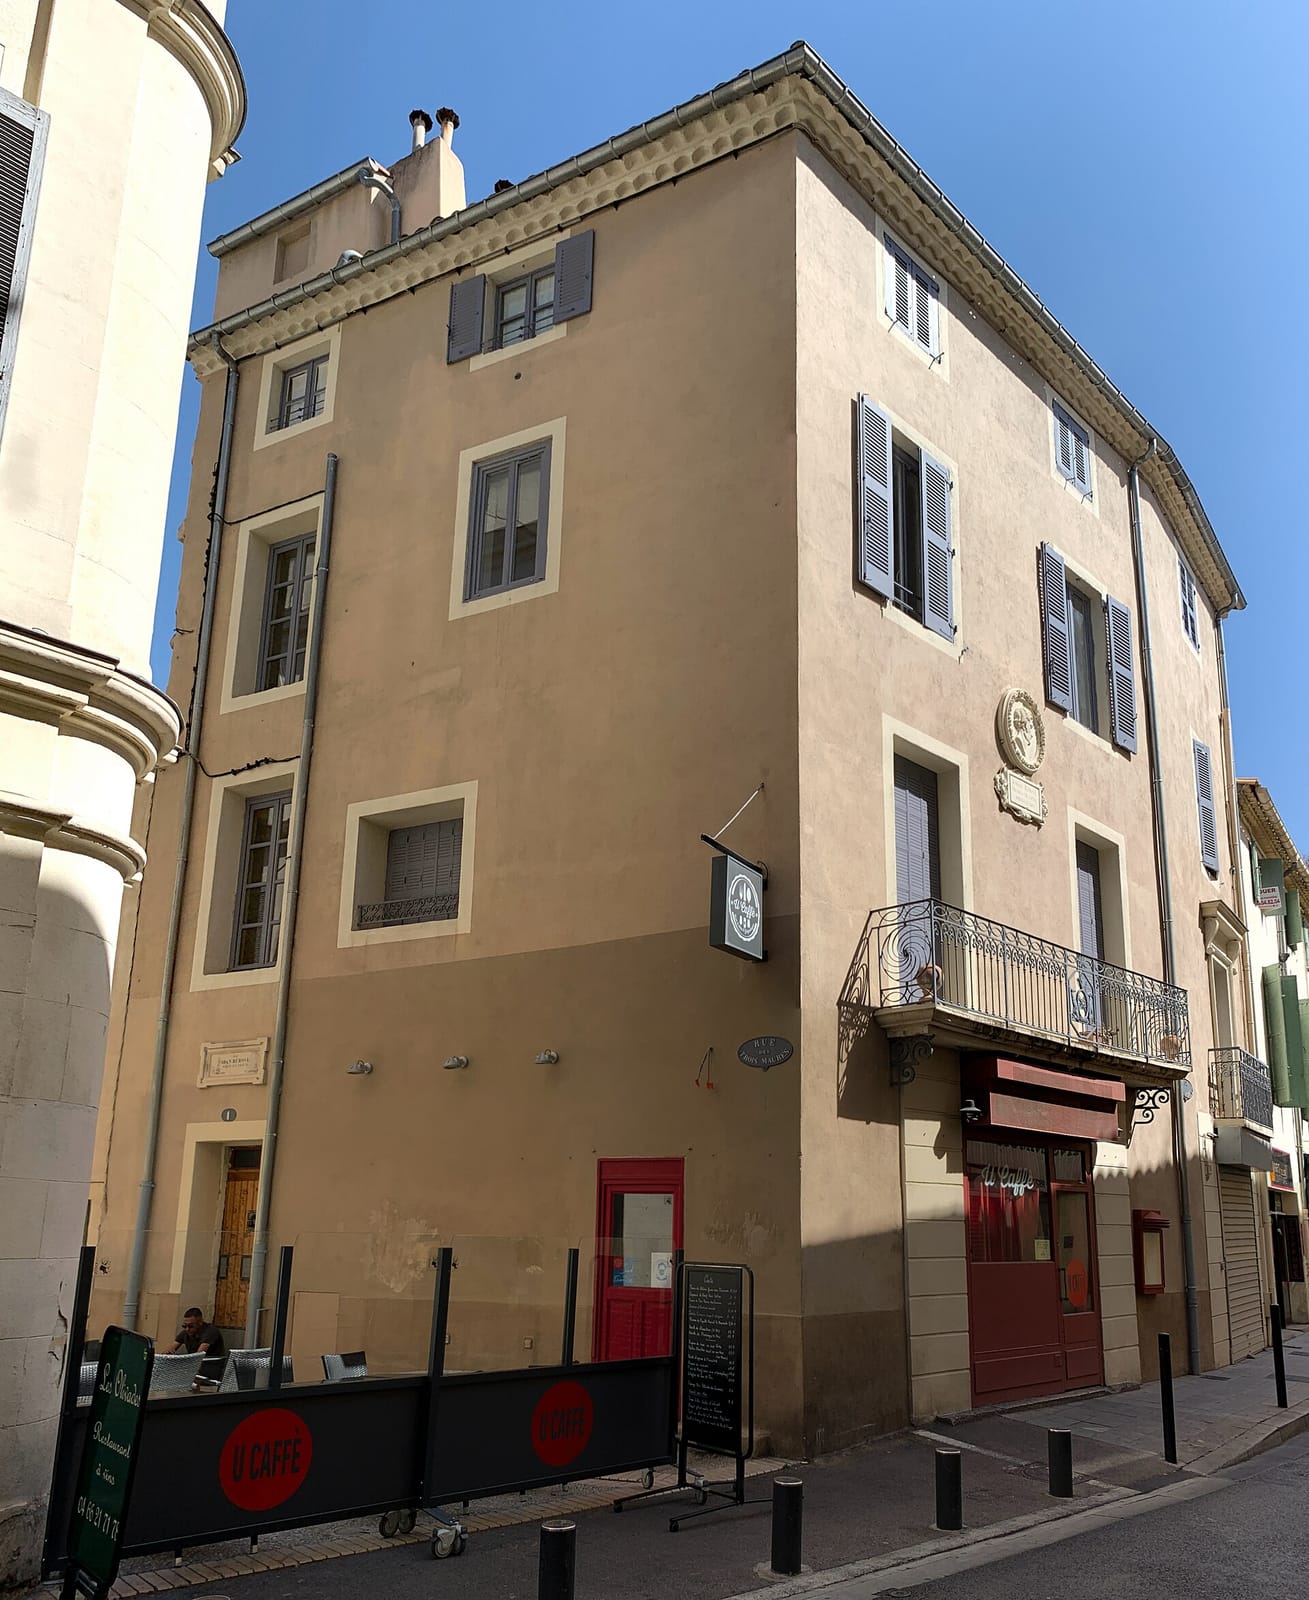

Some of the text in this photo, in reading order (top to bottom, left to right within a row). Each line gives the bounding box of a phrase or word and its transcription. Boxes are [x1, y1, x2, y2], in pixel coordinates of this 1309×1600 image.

[740, 1047, 791, 1065] TROIS MAURES
[753, 1038, 776, 1048] RUE
[99, 1363, 113, 1394] Les
[92, 1420, 131, 1459] Restaurant
[540, 1409, 548, 1442] U
[232, 1442, 246, 1482] U
[77, 1495, 87, 1517] 04
